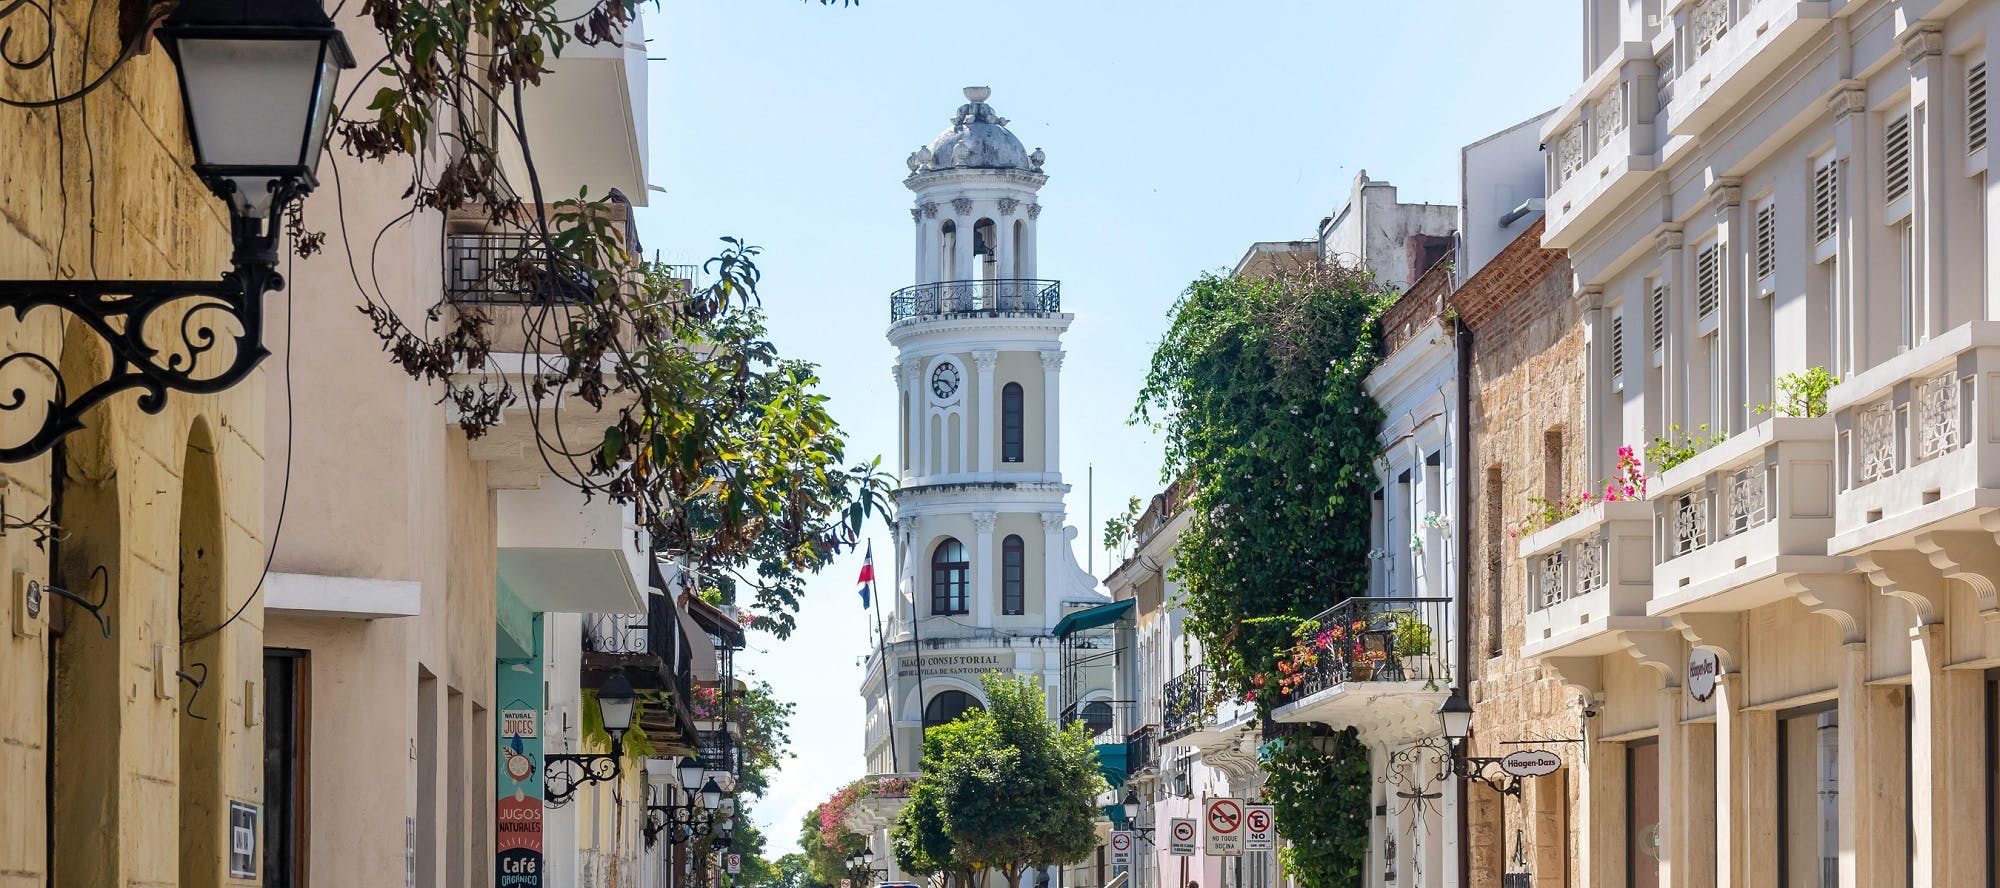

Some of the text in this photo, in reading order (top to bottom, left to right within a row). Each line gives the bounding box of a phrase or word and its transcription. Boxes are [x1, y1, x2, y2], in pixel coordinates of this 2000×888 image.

[902, 656, 999, 668] PALACO CONSISTORIAL
[504, 720, 533, 734] JUICES
[1508, 759, 1555, 769] Häagen-Dazs
[500, 809, 541, 820] JUGOS
[500, 822, 541, 833] NATURALES
[503, 857, 536, 873] Café
[501, 874, 537, 887] ORGÁNICO
